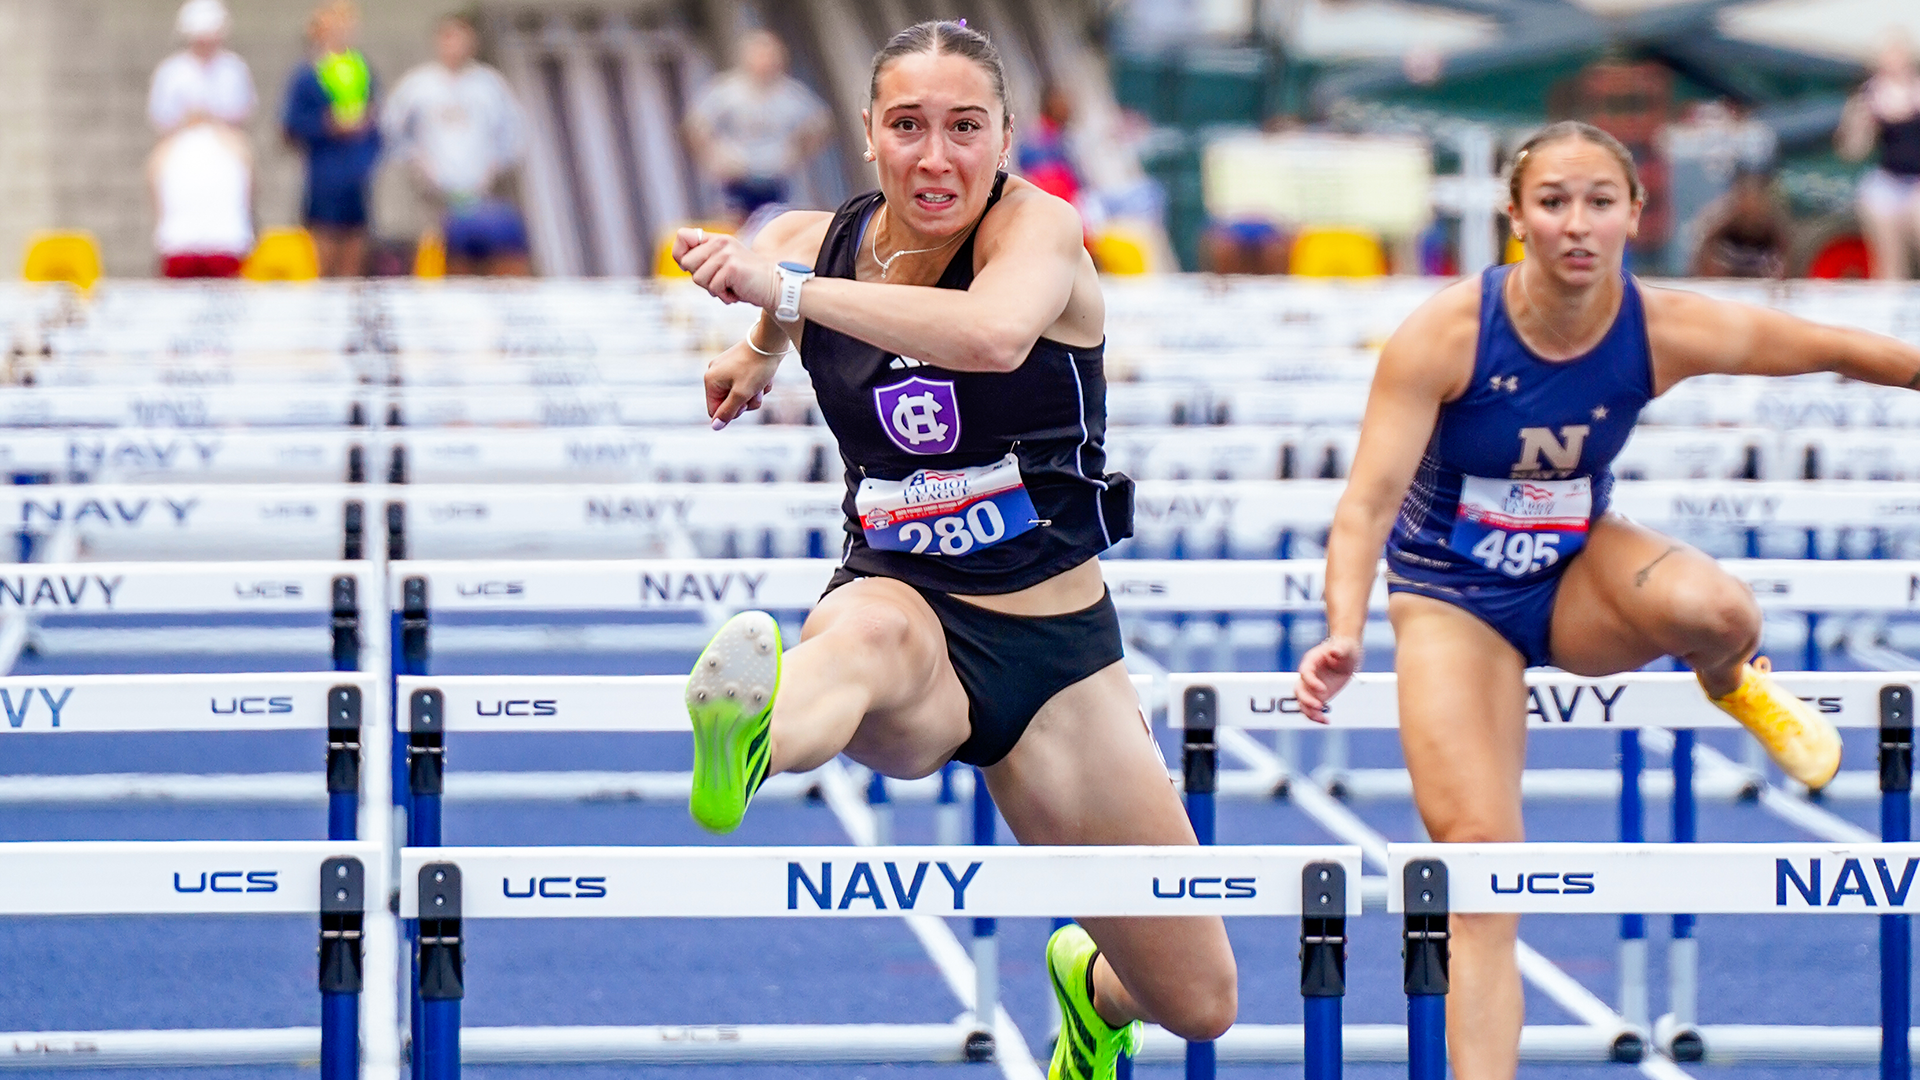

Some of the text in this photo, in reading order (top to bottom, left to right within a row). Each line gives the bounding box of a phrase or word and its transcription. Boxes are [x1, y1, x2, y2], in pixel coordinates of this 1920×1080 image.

[1511, 424, 1590, 471] N
[903, 478, 971, 497] PATRIOT
[904, 486, 972, 505] LEAGUE
[21, 499, 199, 524] NAVY
[585, 498, 693, 521] NAVY
[899, 500, 1006, 556] 280
[1471, 529, 1560, 579] 495
[0, 575, 303, 606] NAVY UCS
[457, 572, 766, 603] UCS NAVY
[211, 696, 293, 714] UCS
[476, 699, 557, 716] UCS
[1250, 685, 1628, 722] UC AVY
[174, 871, 279, 893] UCS
[503, 861, 1257, 910] UCS NAVY UCS
[1491, 857, 1920, 907] UCS NAV
